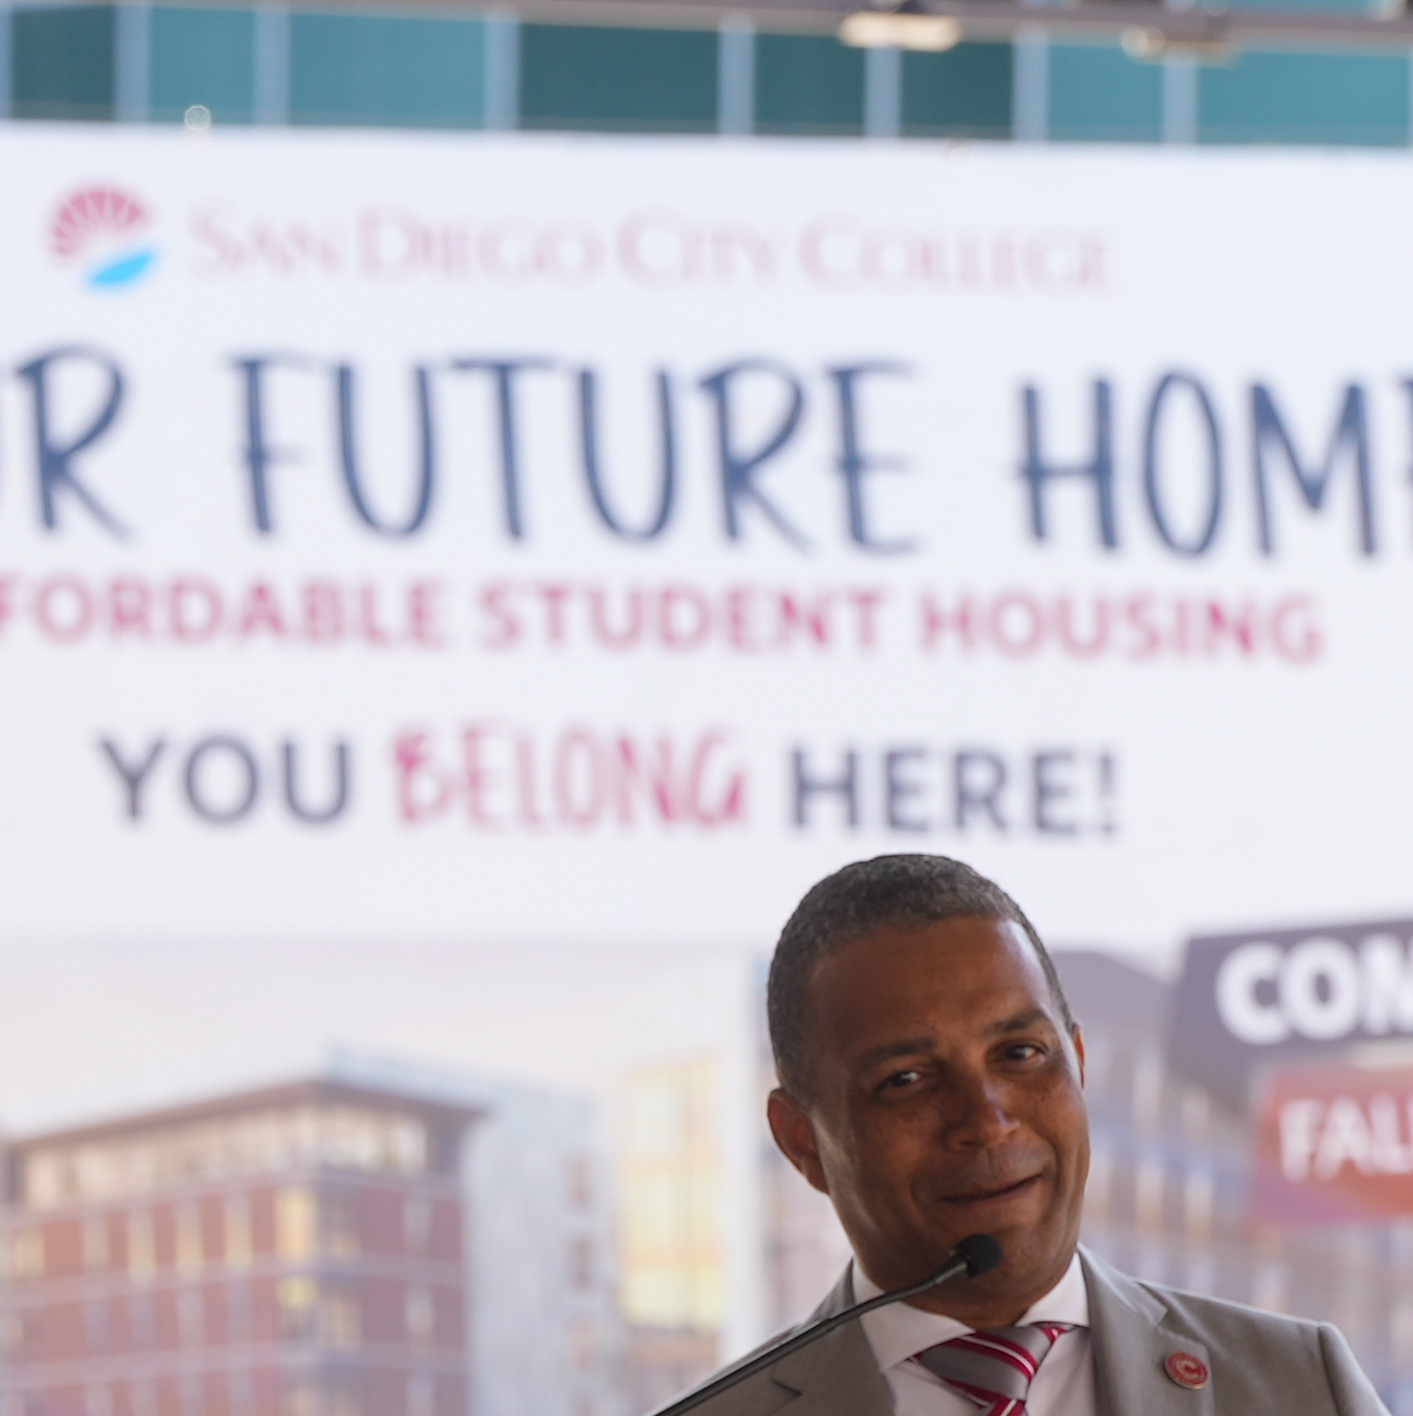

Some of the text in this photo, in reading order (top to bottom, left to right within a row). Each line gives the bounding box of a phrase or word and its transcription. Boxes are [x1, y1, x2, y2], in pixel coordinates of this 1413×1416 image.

[353, 205, 606, 285] DIEGO
[615, 206, 781, 290] CITY
[795, 211, 1113, 295] COLLEGE
[225, 348, 919, 558] FUTURE
[474, 576, 889, 656] STUDENT
[915, 586, 1325, 666] HOUSING
[95, 716, 1121, 840] YOU BELONG HERE!
